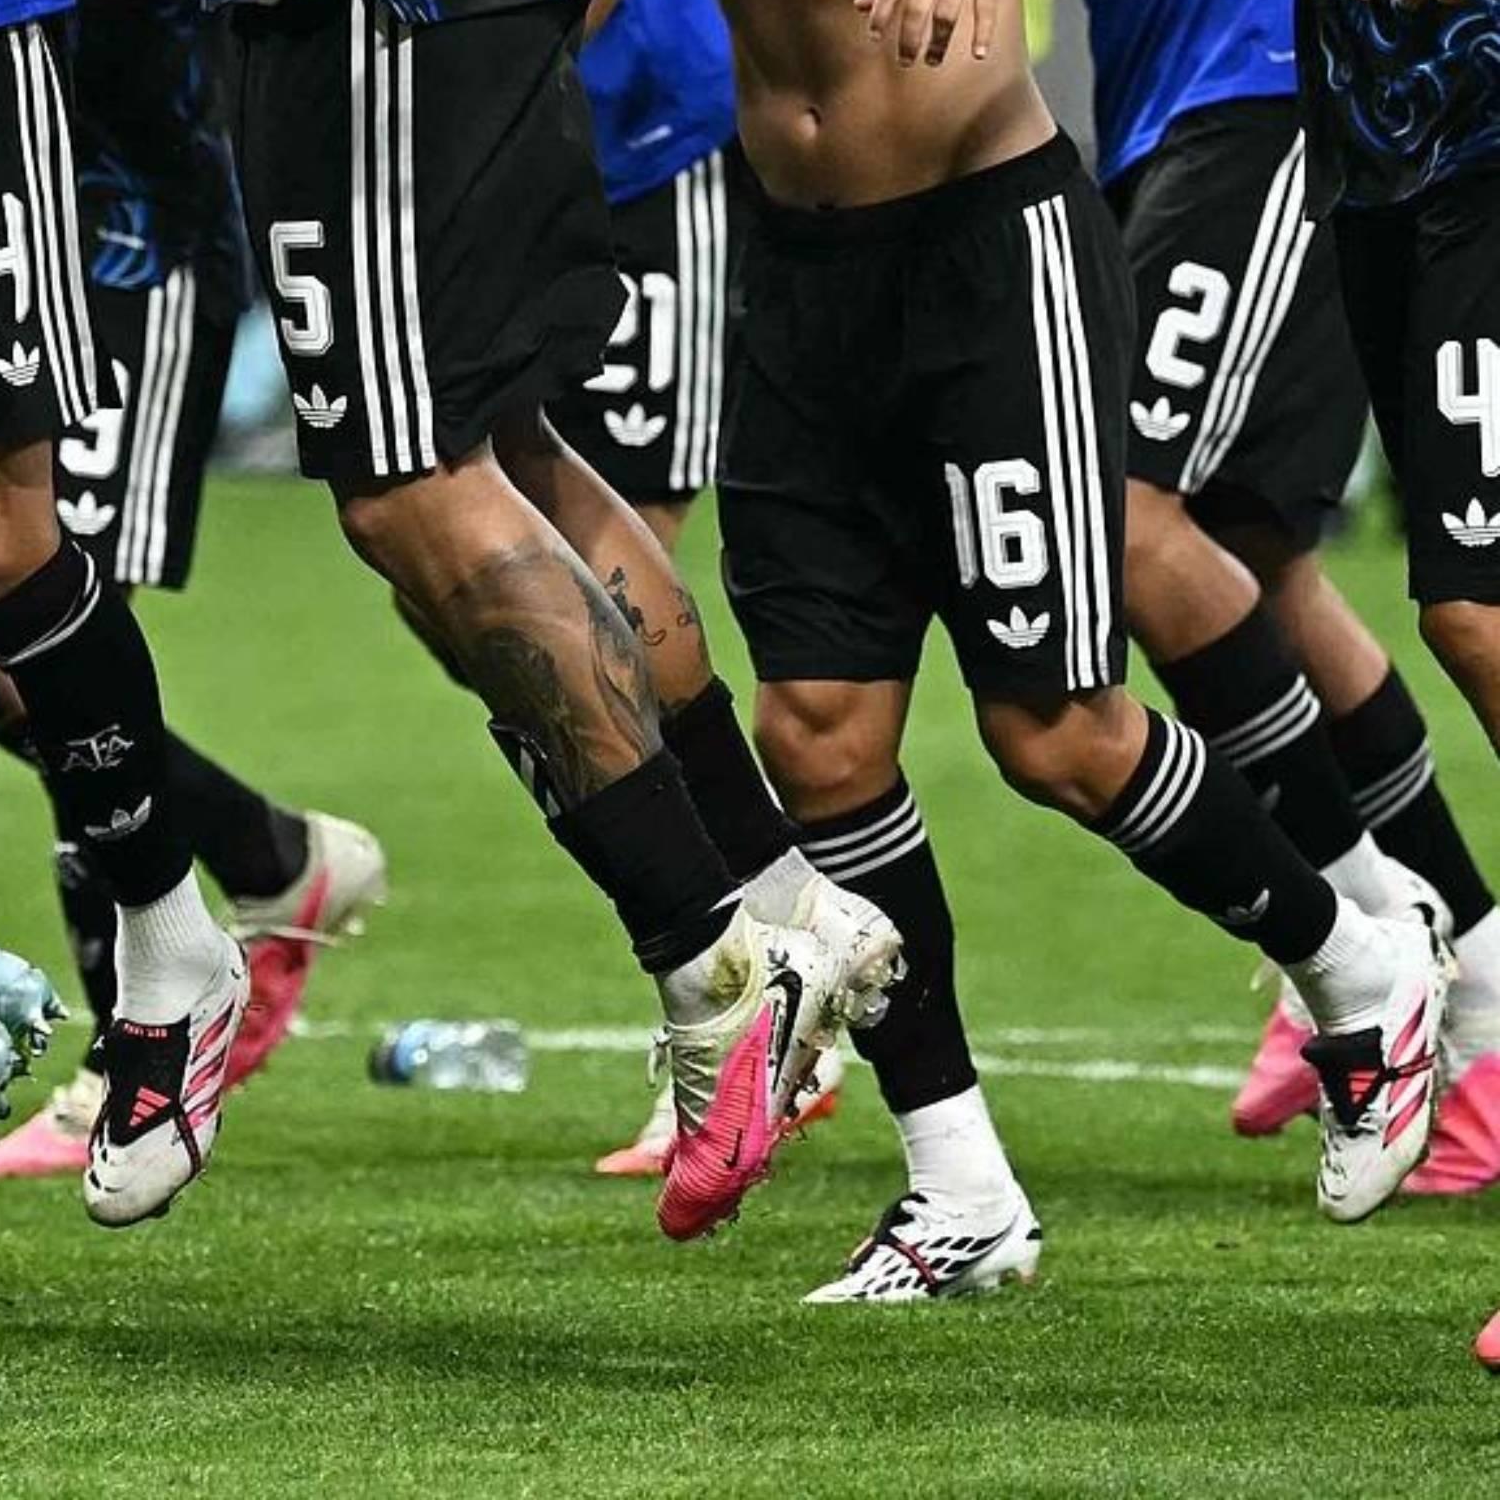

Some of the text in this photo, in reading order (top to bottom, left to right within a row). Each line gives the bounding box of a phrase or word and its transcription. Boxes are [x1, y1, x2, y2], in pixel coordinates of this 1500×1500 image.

[269, 220, 334, 356] 5
[1145, 261, 1231, 387] 2
[1436, 338, 1500, 477] 4
[944, 458, 1049, 589] 16
